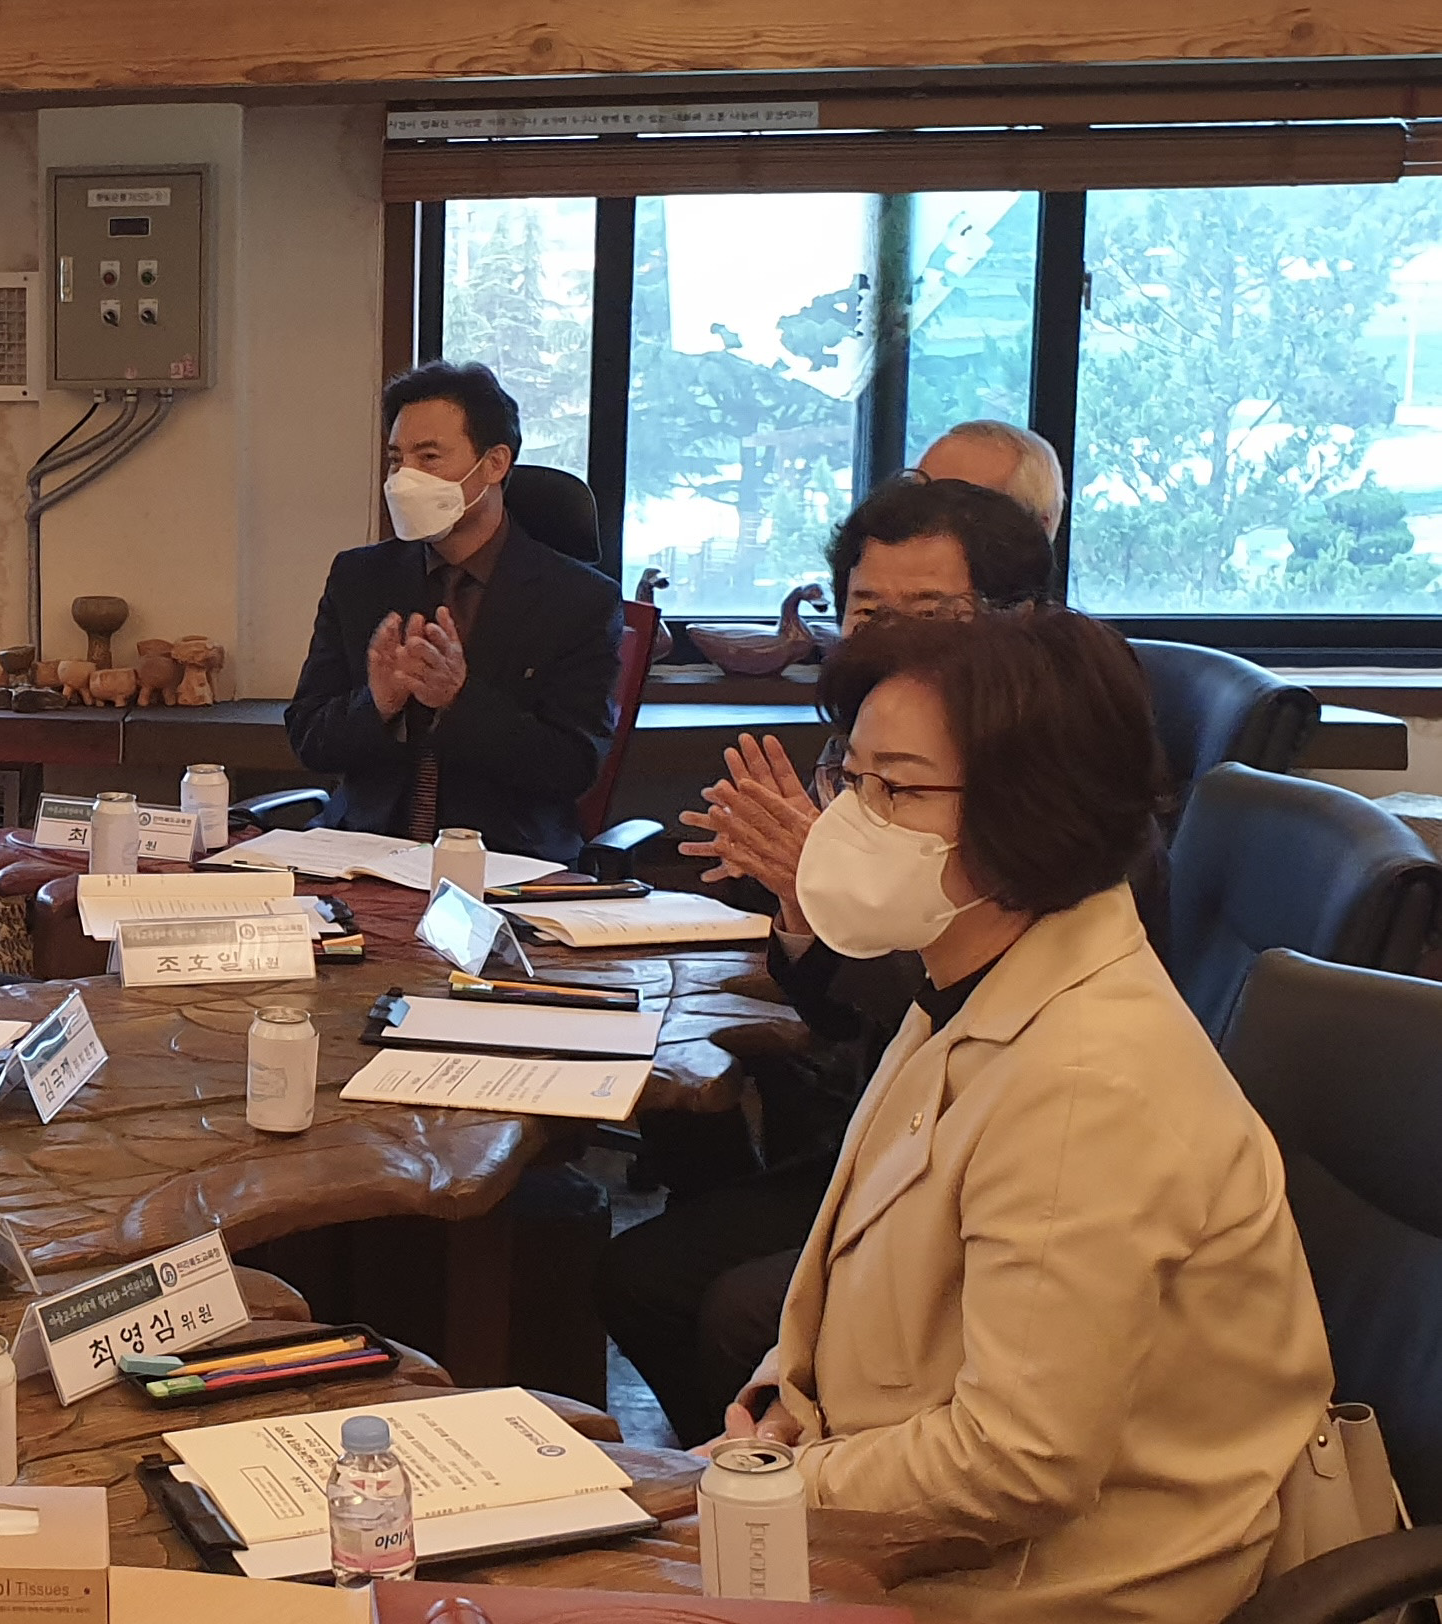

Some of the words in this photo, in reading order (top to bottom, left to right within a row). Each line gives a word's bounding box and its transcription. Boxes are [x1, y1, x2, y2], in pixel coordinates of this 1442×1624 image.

[156, 951, 242, 974] 조호일
[246, 957, 280, 971] 위원
[88, 1309, 176, 1369] 최영심
[181, 1303, 215, 1332] 위원
[15, 1582, 70, 1597] Tissues
